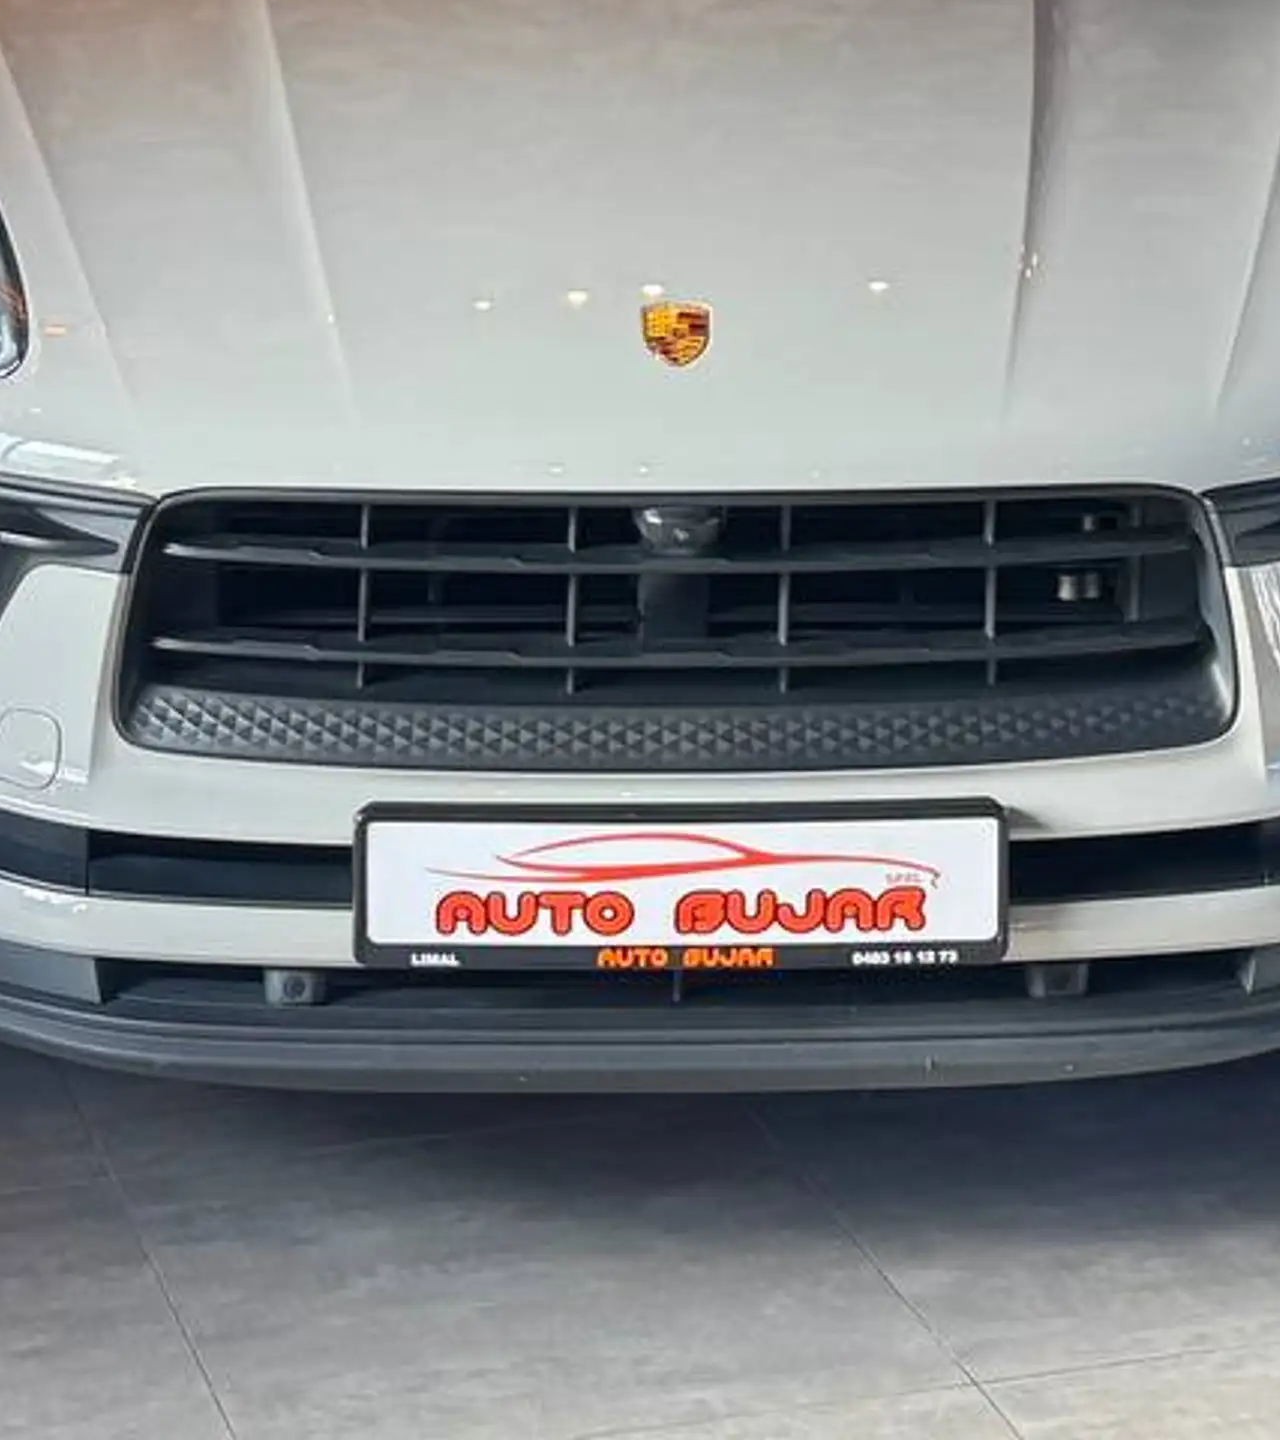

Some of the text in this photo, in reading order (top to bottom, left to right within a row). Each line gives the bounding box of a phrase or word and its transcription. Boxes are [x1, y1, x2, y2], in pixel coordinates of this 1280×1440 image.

[436, 887, 926, 936] AUTO BUJAR
[597, 948, 773, 968] AUTO BUJAR
